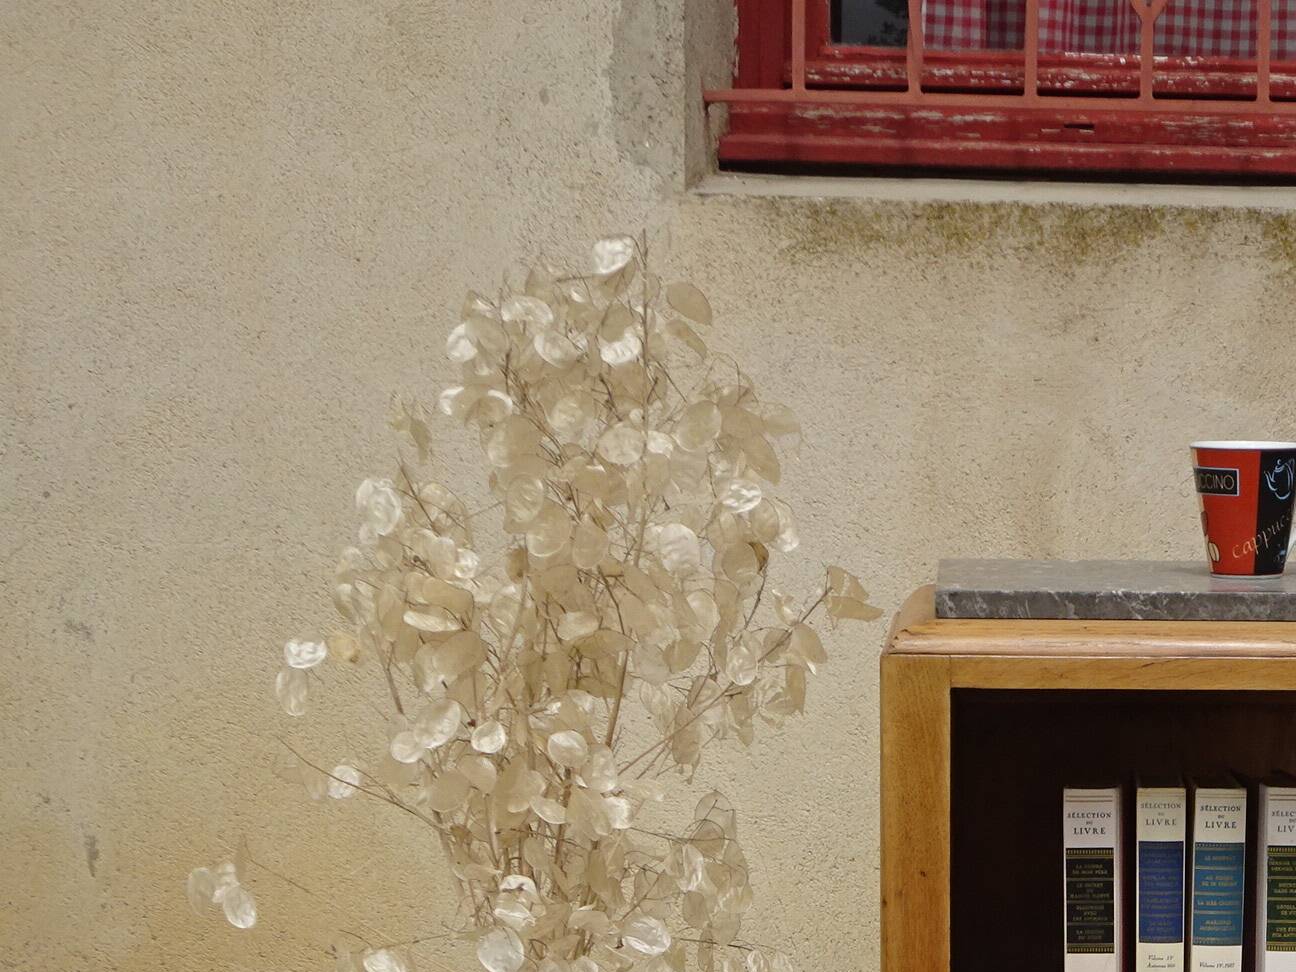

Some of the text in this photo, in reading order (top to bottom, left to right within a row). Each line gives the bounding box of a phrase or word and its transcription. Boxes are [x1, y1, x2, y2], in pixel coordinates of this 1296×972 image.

[1145, 818, 1177, 826] LIVRE
[1205, 821, 1237, 829] LIVRE
[1073, 827, 1106, 835] LIVRE
